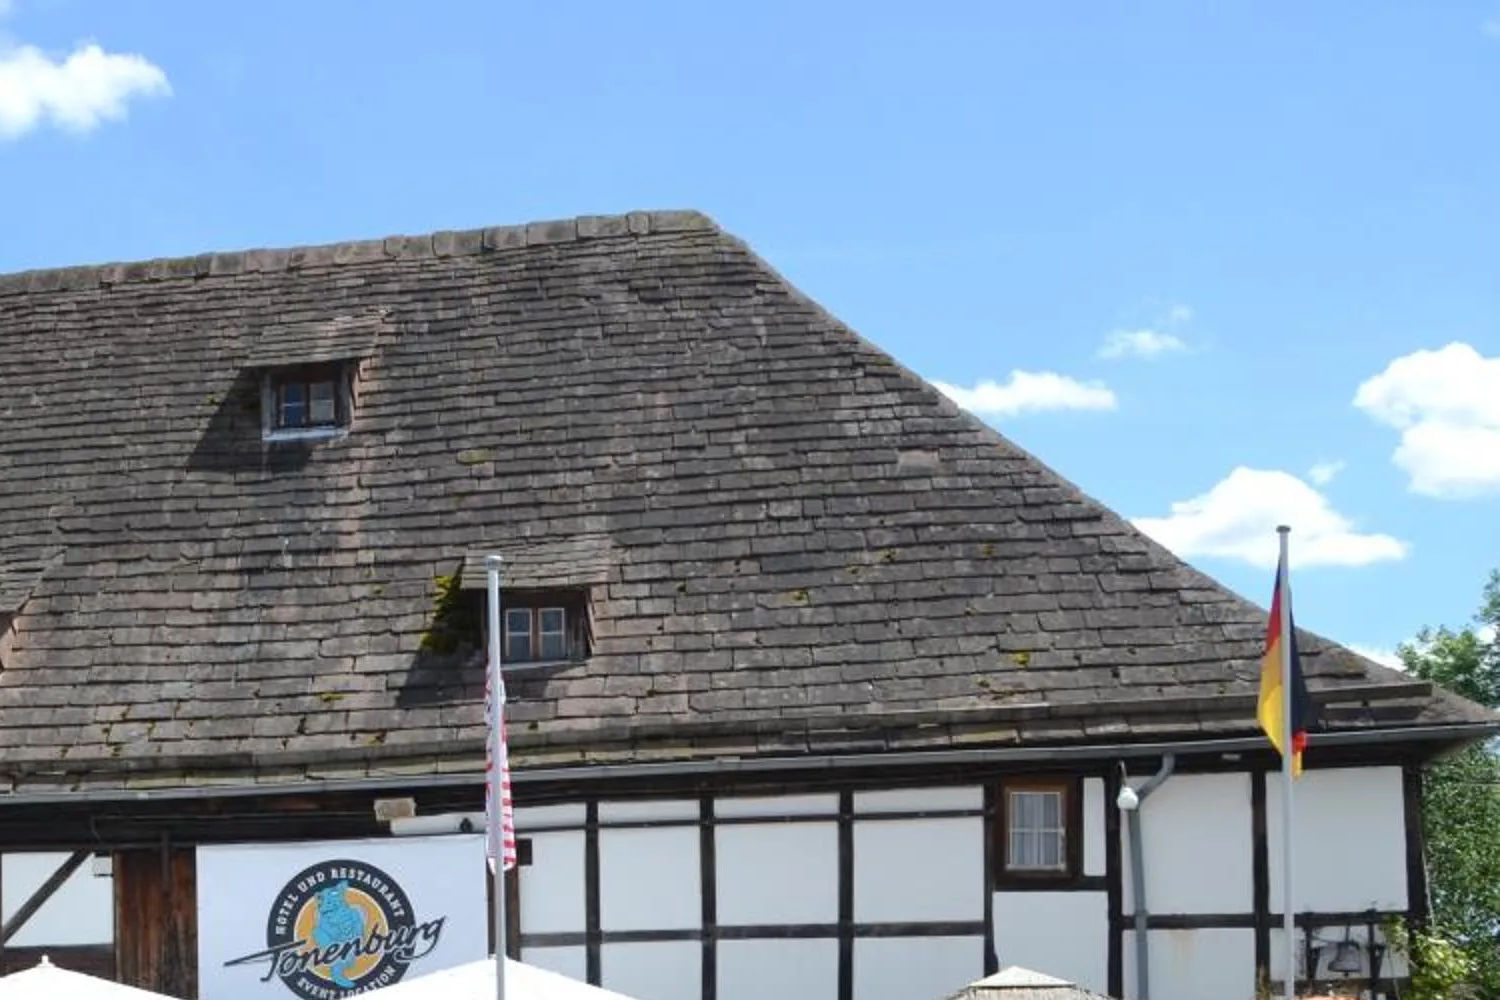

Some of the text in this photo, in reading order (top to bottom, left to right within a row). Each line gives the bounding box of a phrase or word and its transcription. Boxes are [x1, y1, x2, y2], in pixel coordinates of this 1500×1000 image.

[276, 867, 405, 935] HOTEL UND RESTAURANT
[296, 964, 397, 1000] EVENT LOCATION
